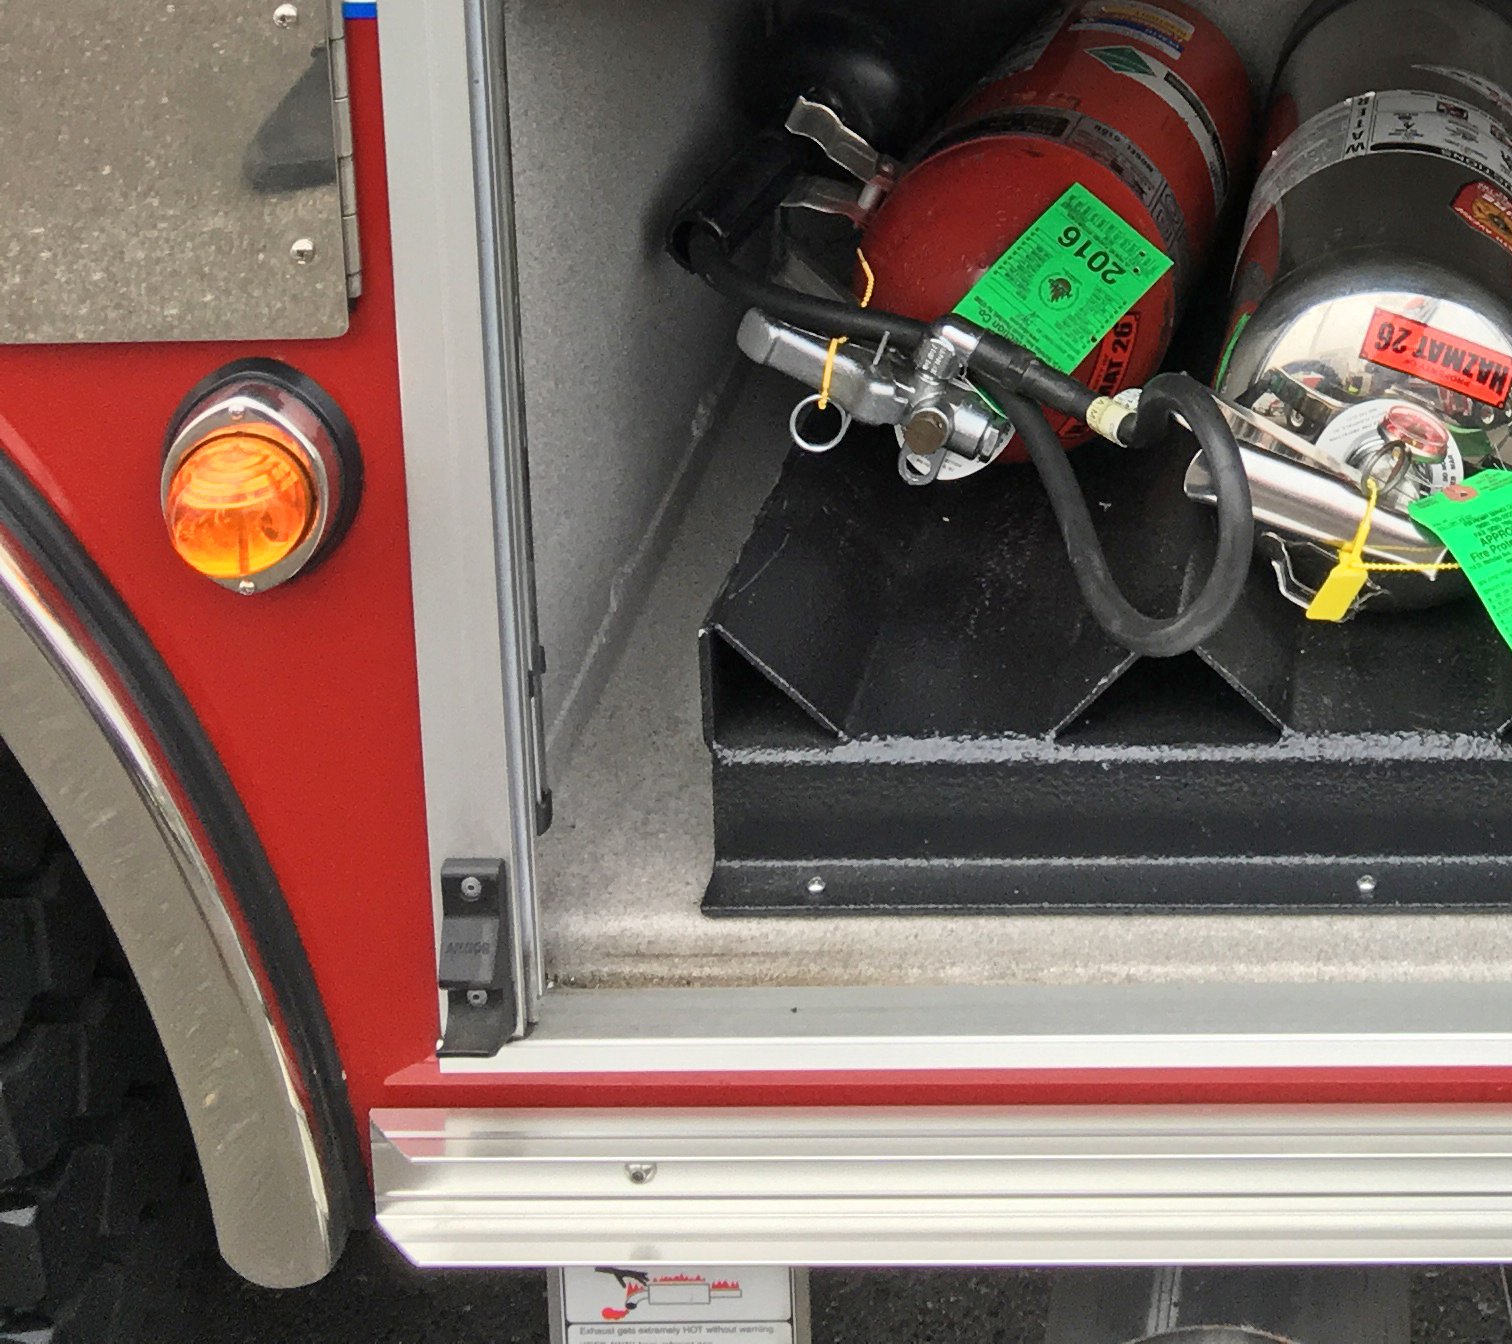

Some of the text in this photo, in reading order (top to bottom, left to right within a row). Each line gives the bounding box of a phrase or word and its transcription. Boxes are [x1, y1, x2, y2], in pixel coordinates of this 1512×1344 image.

[1057, 226, 1126, 285] 2016
[1372, 320, 1511, 395] HAZMAT 26
[1469, 547, 1489, 562] Fire
[638, 1327, 680, 1336] extremely
[683, 1326, 704, 1334] HOT
[706, 1326, 737, 1334] without
